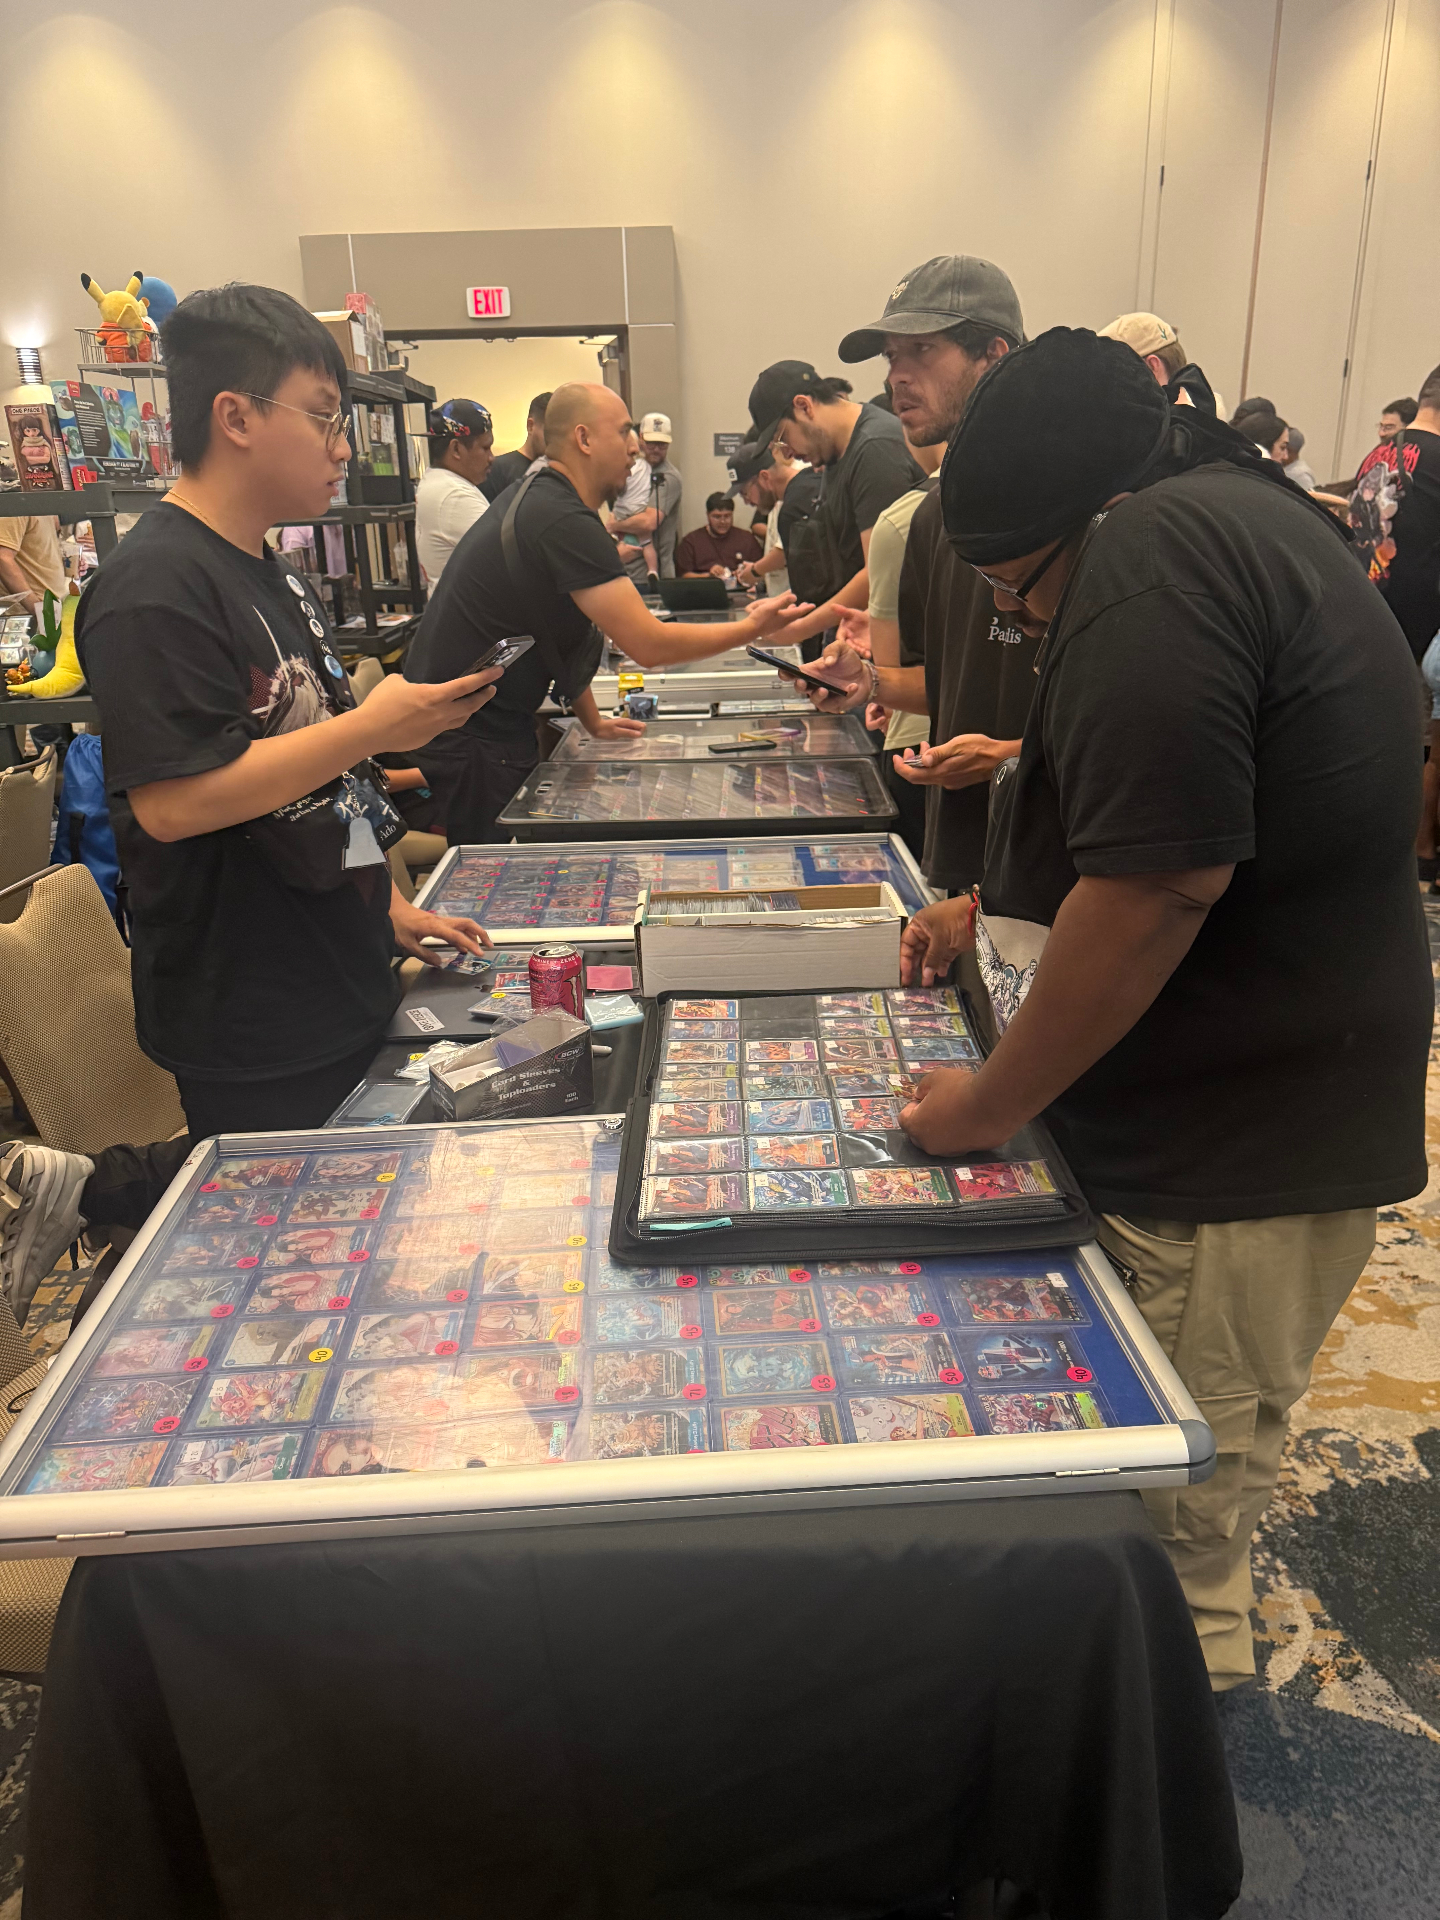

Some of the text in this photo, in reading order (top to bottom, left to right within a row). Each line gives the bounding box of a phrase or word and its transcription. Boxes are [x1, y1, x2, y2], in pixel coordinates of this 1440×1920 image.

[473, 289, 503, 314] EXIT
[559, 1048, 581, 1058] BCW
[491, 1066, 561, 1089] Card Sleeves
[522, 1079, 532, 1087] &
[497, 1081, 557, 1101] Toploaders
[905, 1265, 917, 1273] 43
[796, 1272, 808, 1280] 43
[923, 1316, 935, 1324] 43
[805, 1321, 816, 1330] 66
[685, 1327, 699, 1337] 45
[314, 1351, 328, 1360] 40
[945, 1372, 958, 1382] 50
[1074, 1369, 1088, 1380] 40
[817, 1378, 831, 1389] 65
[689, 1388, 702, 1397] 71
